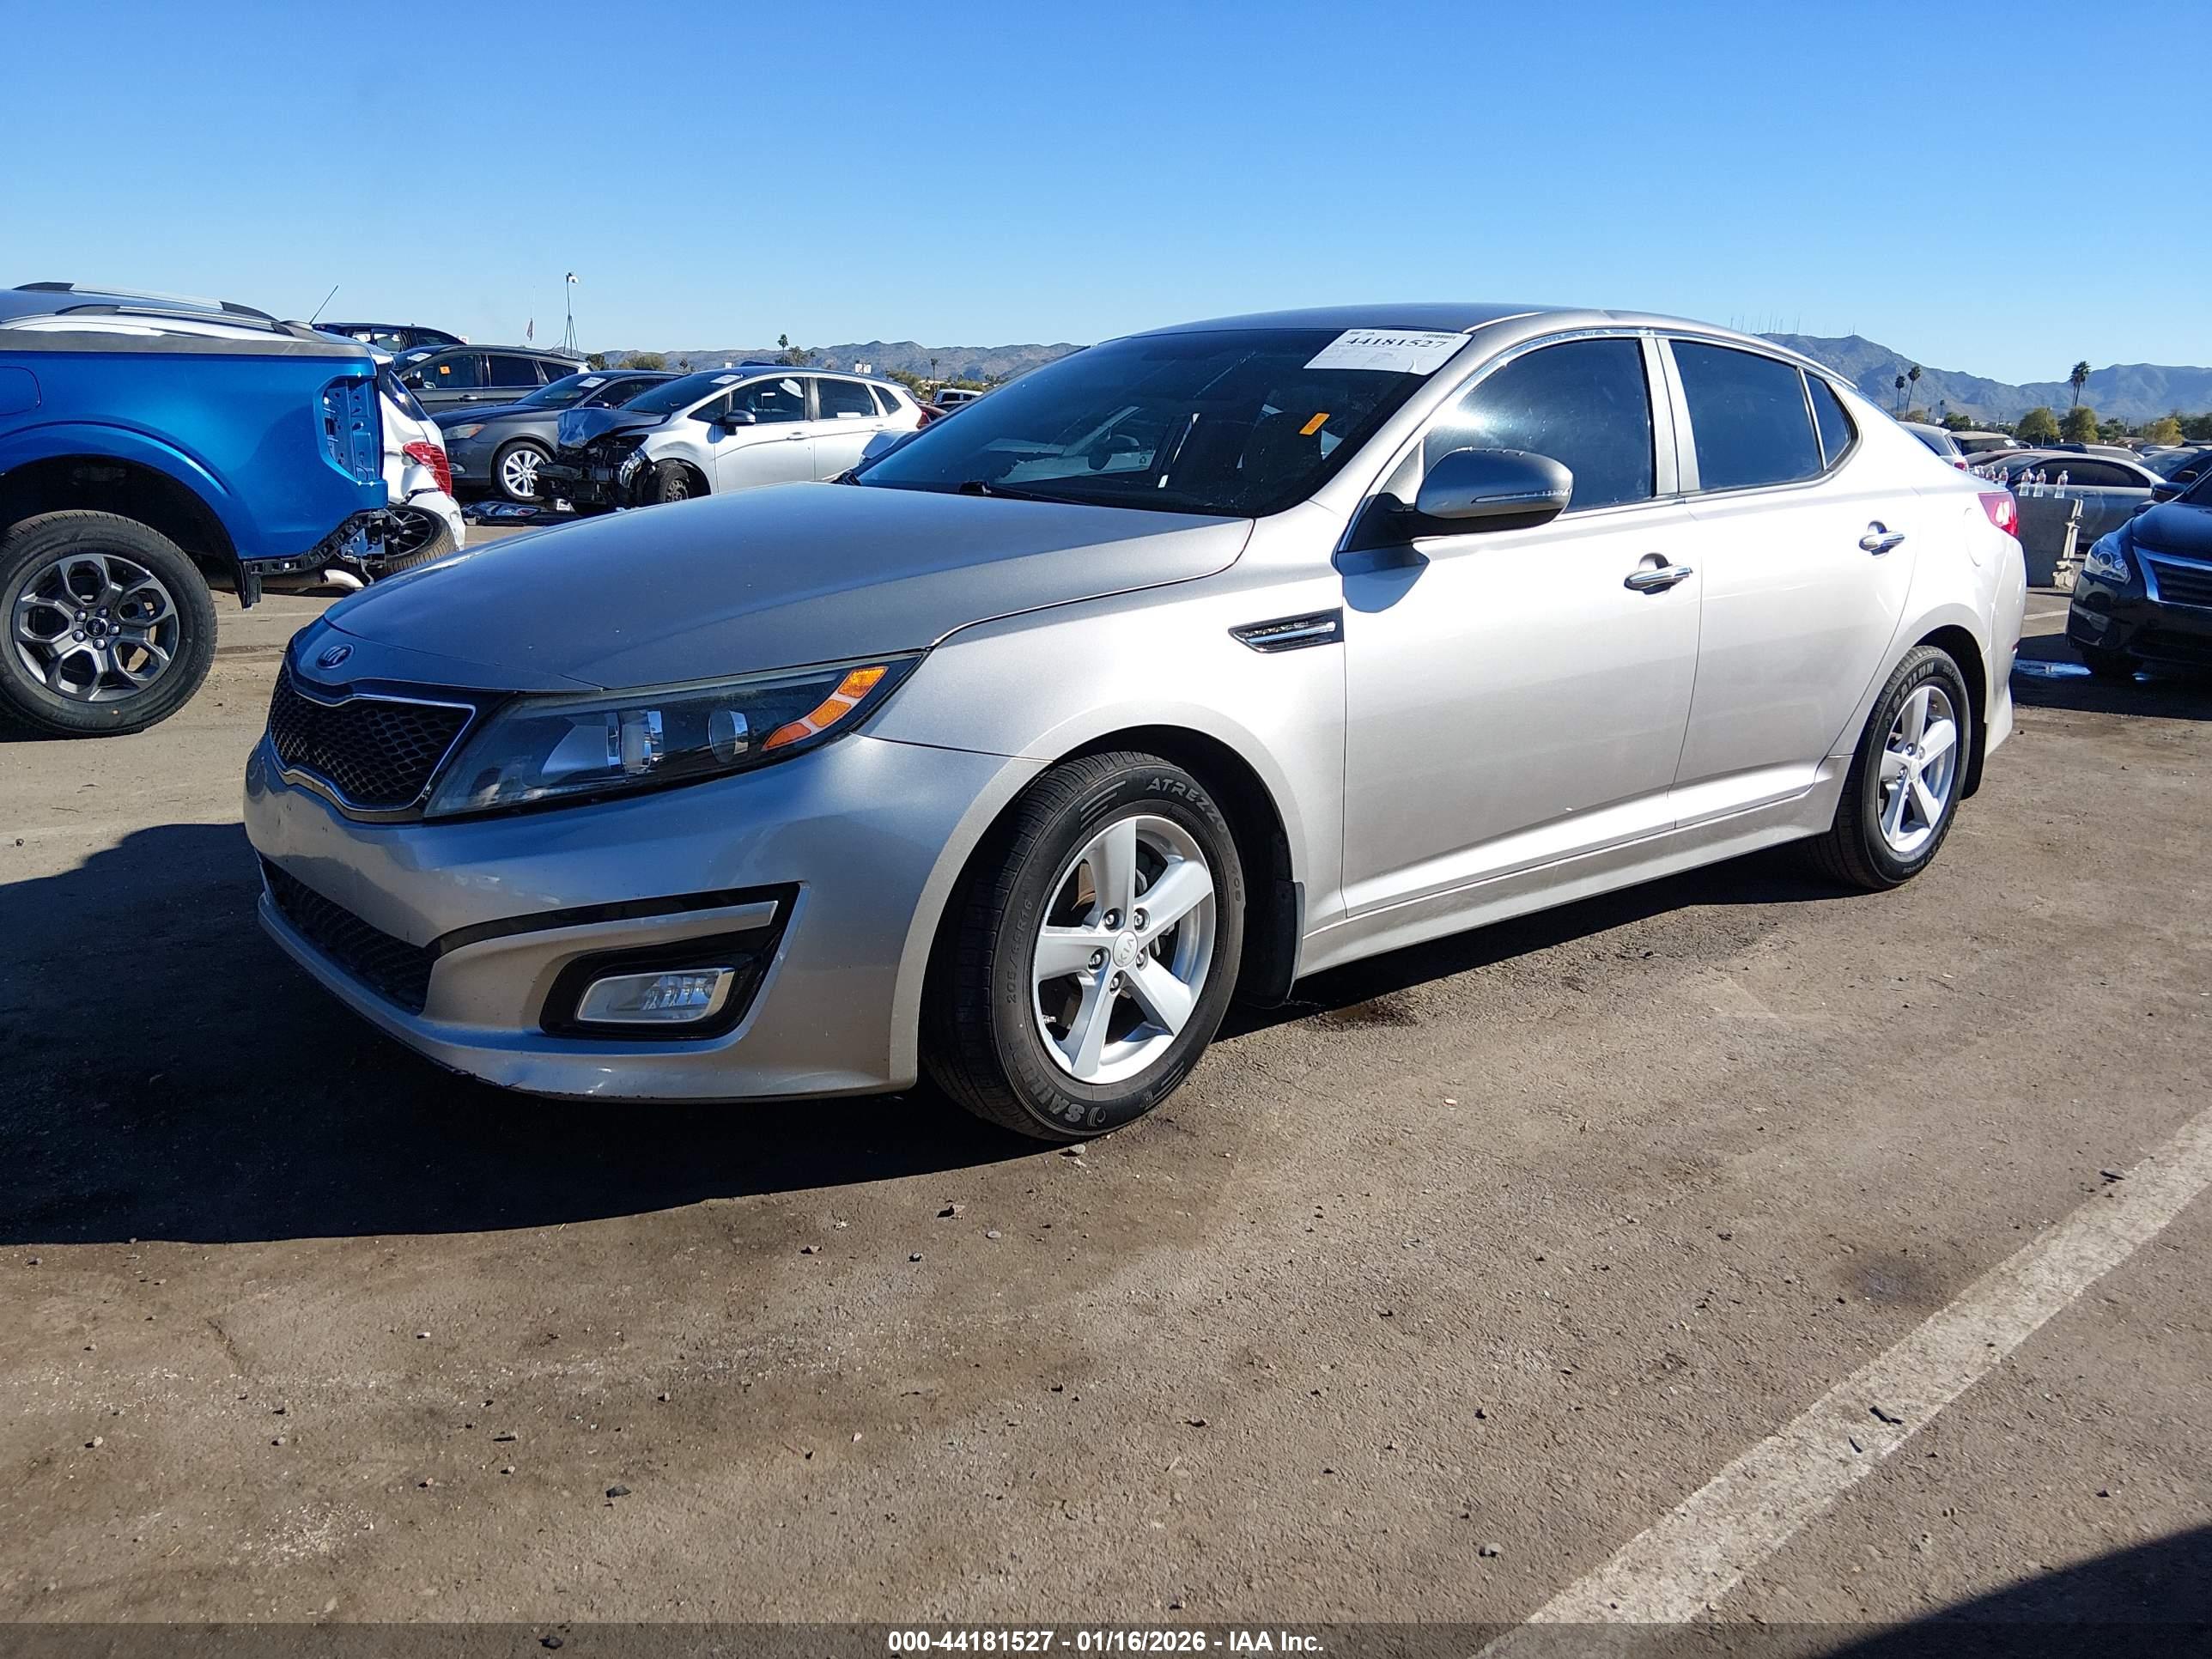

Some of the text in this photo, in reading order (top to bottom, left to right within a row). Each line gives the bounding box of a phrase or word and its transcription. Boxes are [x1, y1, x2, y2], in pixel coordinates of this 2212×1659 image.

[1346, 337, 1449, 349] 44181527
[1146, 777, 1227, 834] ATREZZO
[1006, 899, 1033, 1004] 205/65R16
[1118, 939, 1134, 964] KIA
